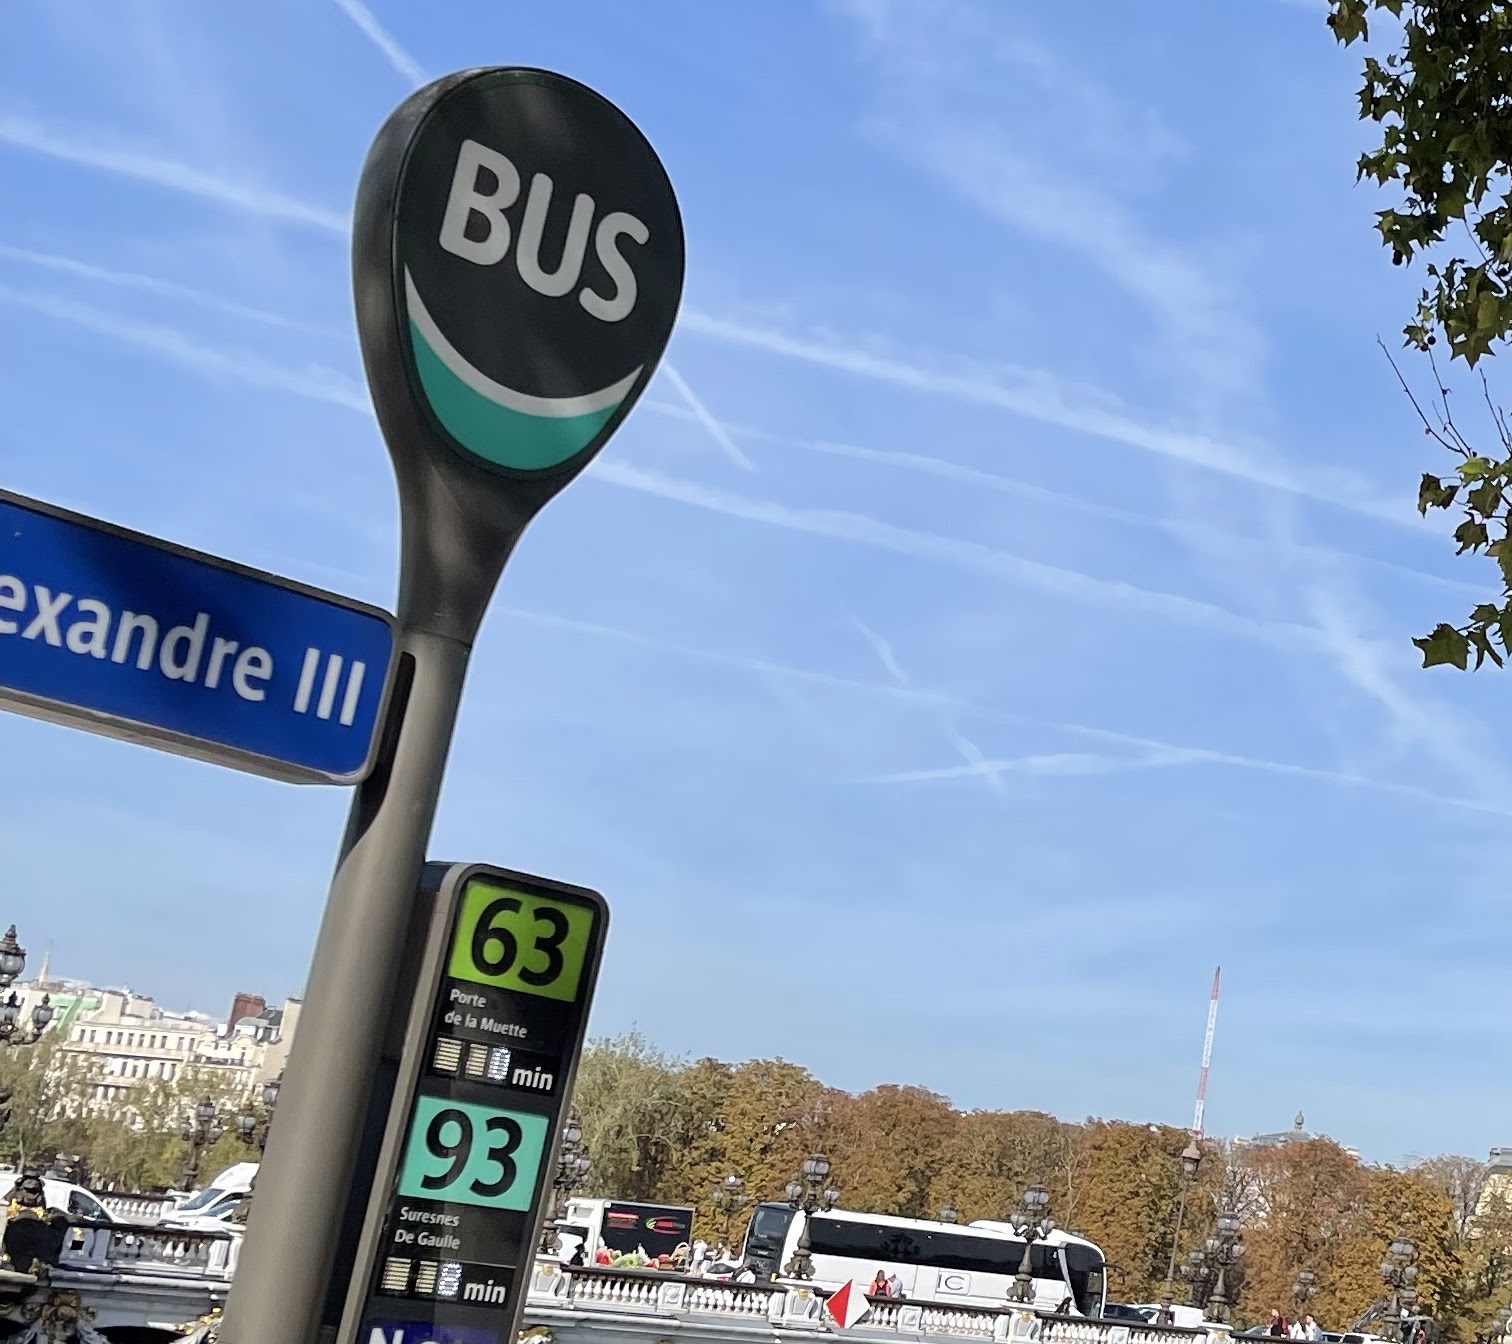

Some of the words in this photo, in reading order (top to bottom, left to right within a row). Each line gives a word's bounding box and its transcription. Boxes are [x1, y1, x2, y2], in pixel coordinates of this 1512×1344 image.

[439, 139, 649, 323] BUS
[293, 647, 366, 727] III
[470, 897, 570, 987] 63
[450, 988, 487, 1008] Porte
[444, 1010, 462, 1026] de
[464, 1013, 478, 1029] la
[480, 1017, 528, 1039] Muette
[511, 1066, 553, 1091] min
[420, 1108, 523, 1199] 93
[399, 1206, 460, 1227] Suresnes
[394, 1229, 415, 1244] De
[417, 1231, 461, 1250] Gaulle
[463, 1279, 506, 1304] min
